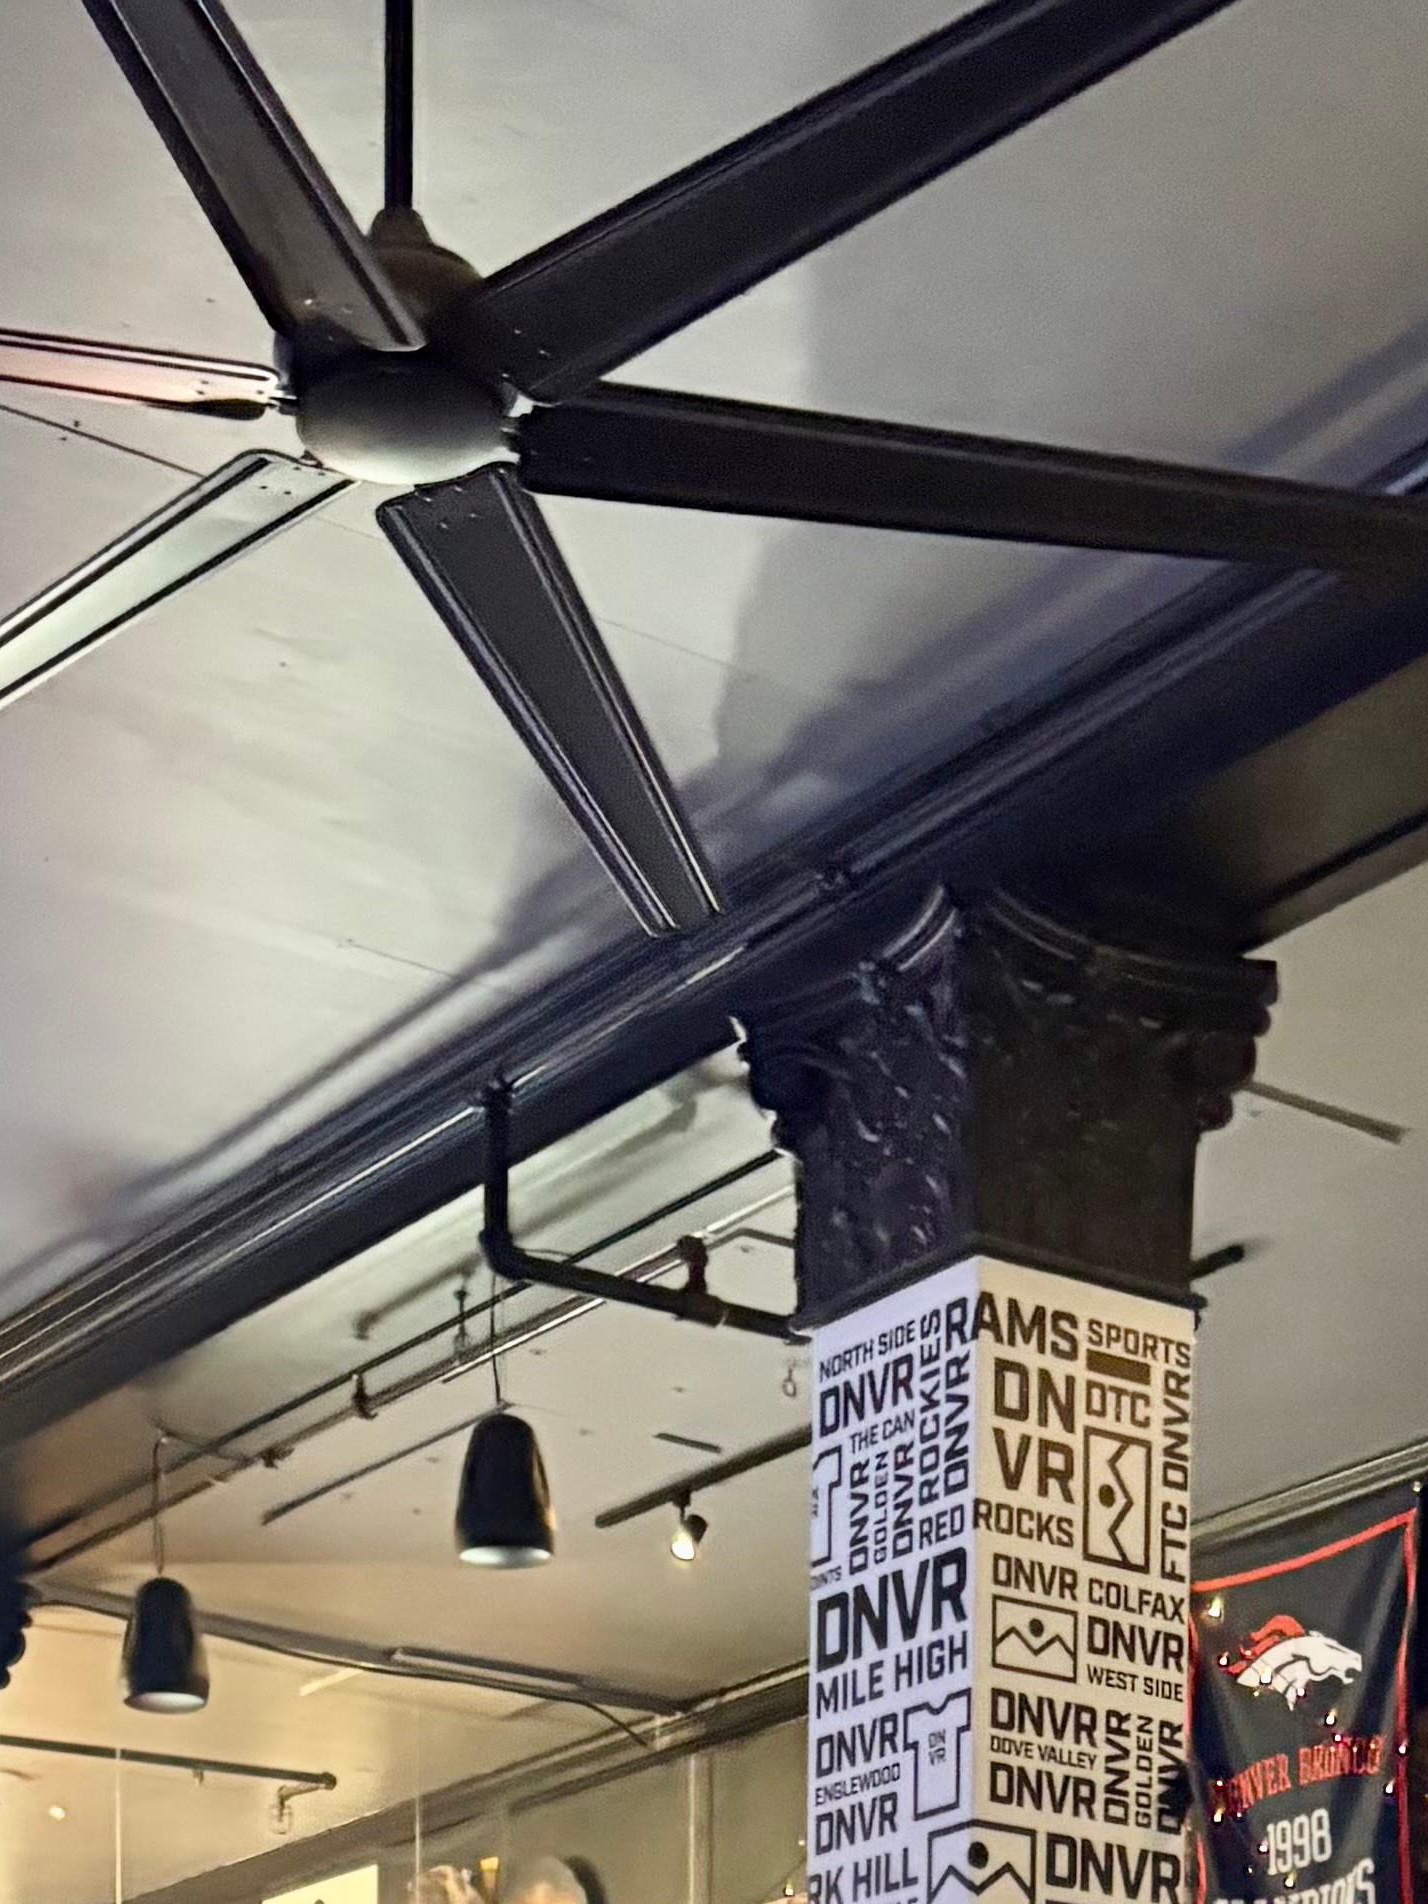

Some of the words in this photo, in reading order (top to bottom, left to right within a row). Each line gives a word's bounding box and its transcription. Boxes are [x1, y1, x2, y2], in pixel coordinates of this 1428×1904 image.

[819, 1331, 875, 1383] NORTH
[879, 1320, 915, 1356] SIDE
[945, 1292, 1080, 1361] RAMS
[1088, 1320, 1191, 1368] SPORTS
[820, 1354, 913, 1436] DNVR
[919, 1310, 941, 1506] ROCKIES
[944, 1349, 971, 1496] DNVR
[1087, 1379, 1151, 1428] DTC
[850, 1421, 878, 1456] THE
[880, 1409, 914, 1446] CAN
[1162, 1372, 1191, 1491] DNVR
[849, 1461, 869, 1574] DNVR
[873, 1451, 888, 1564] GOLDEN
[893, 1441, 914, 1558] DNVR
[920, 1506, 964, 1551] RED
[973, 1498, 1074, 1548] ROCKS
[992, 1552, 1077, 1600] DNVR
[1161, 1505, 1187, 1581] FTC
[817, 1547, 967, 1673] DNVR
[1088, 1578, 1186, 1626] COLFAX
[816, 1672, 883, 1720] MILE
[895, 1630, 968, 1688] HIGH
[1088, 1615, 1185, 1672] DNVR
[1087, 1663, 1137, 1694] WEST
[1142, 1670, 1184, 1703] SIDE
[816, 1713, 898, 1777] DNVR
[991, 1688, 1098, 1748] DNVR
[815, 1762, 900, 1805] ENGLEWOOD
[991, 1735, 1032, 1761] DOVE
[1038, 1743, 1098, 1771] VALLEY
[1105, 1712, 1130, 1825] DNVR
[1136, 1716, 1155, 1828] GOLDEN
[991, 1761, 1096, 1819] DNVR
[815, 1793, 898, 1855] DNVR
[1267, 1808, 1332, 1876] 1998
[1046, 1834, 1181, 1904] DNVR
